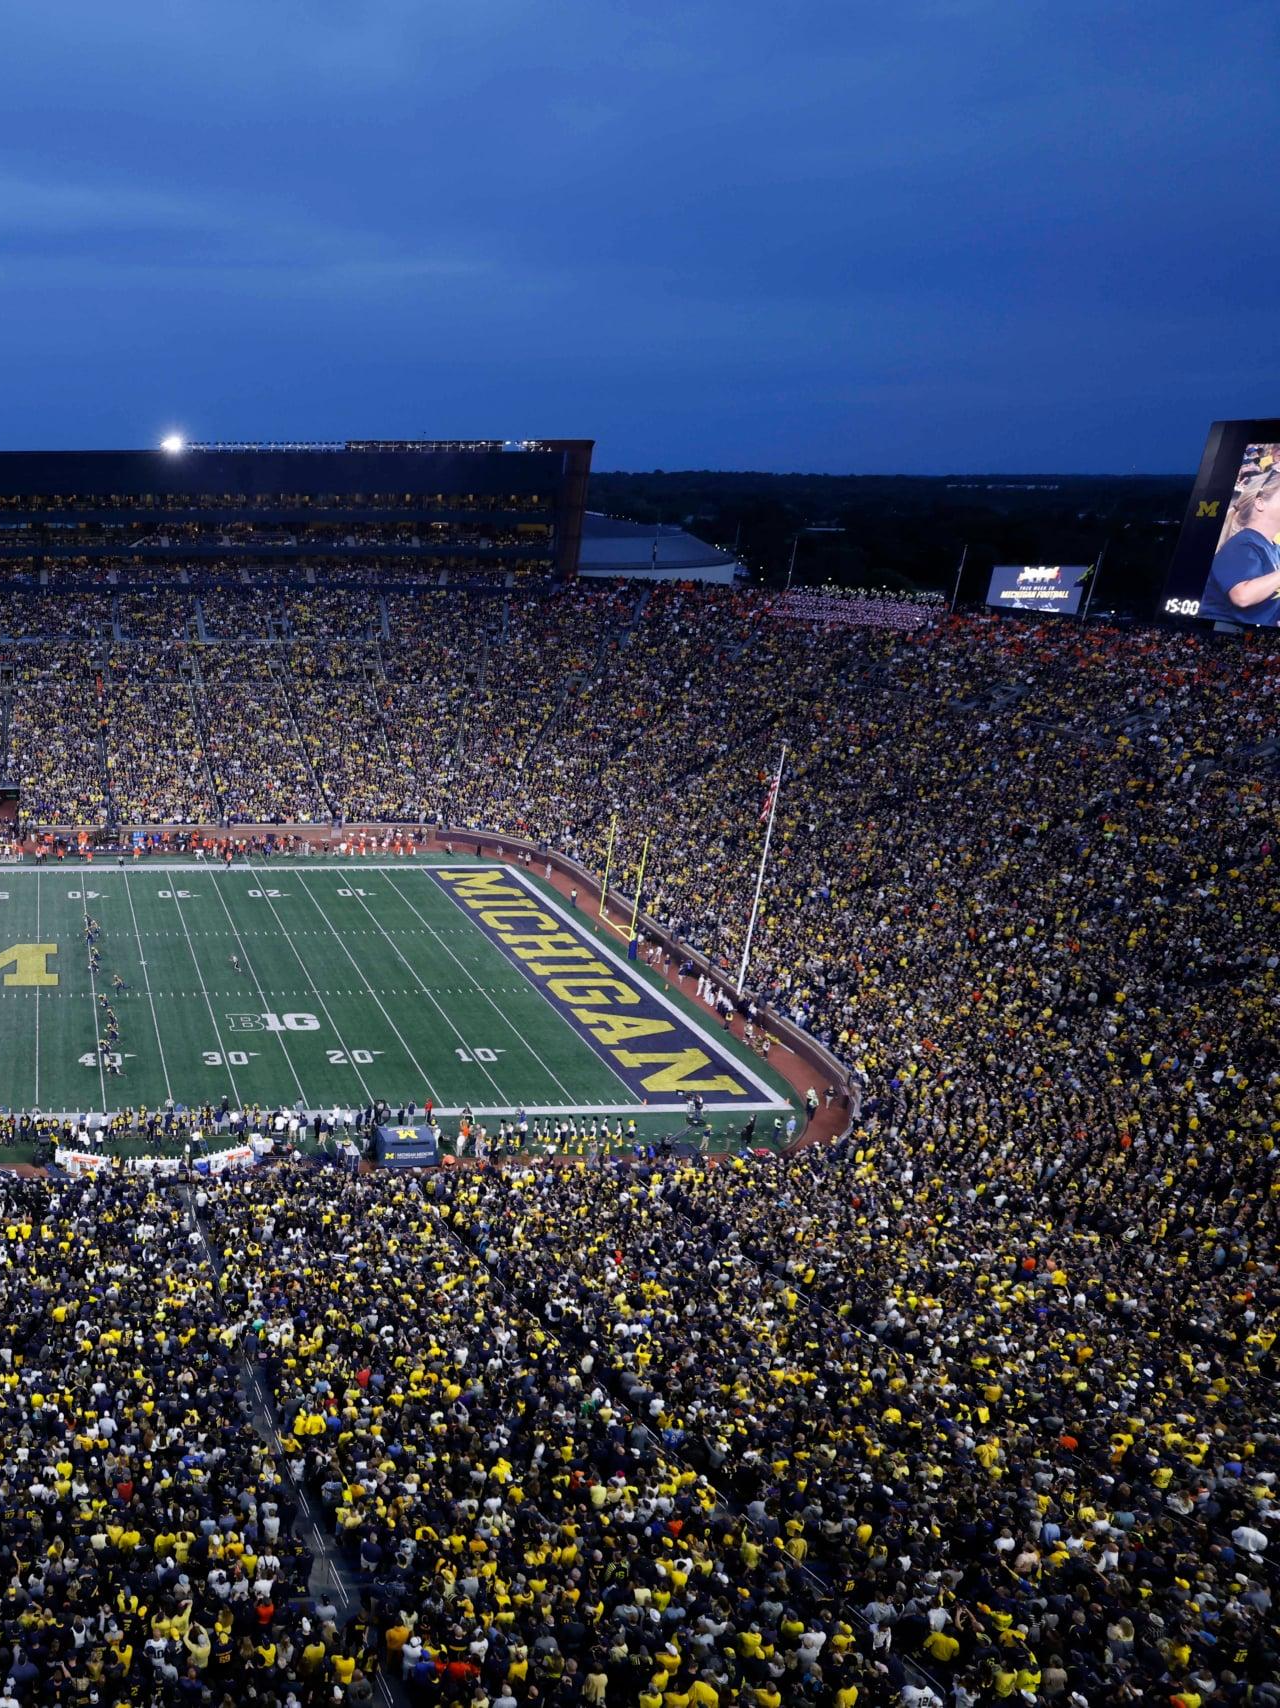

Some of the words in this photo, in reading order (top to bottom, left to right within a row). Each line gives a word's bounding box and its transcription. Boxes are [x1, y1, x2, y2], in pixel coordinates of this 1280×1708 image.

[1196, 501, 1220, 517] M
[1165, 599, 1200, 616] 15:00
[437, 870, 748, 1096] MICHIGAN
[202, 1051, 249, 1065] 30
[326, 1050, 373, 1064] 20
[455, 1048, 498, 1062] 10
